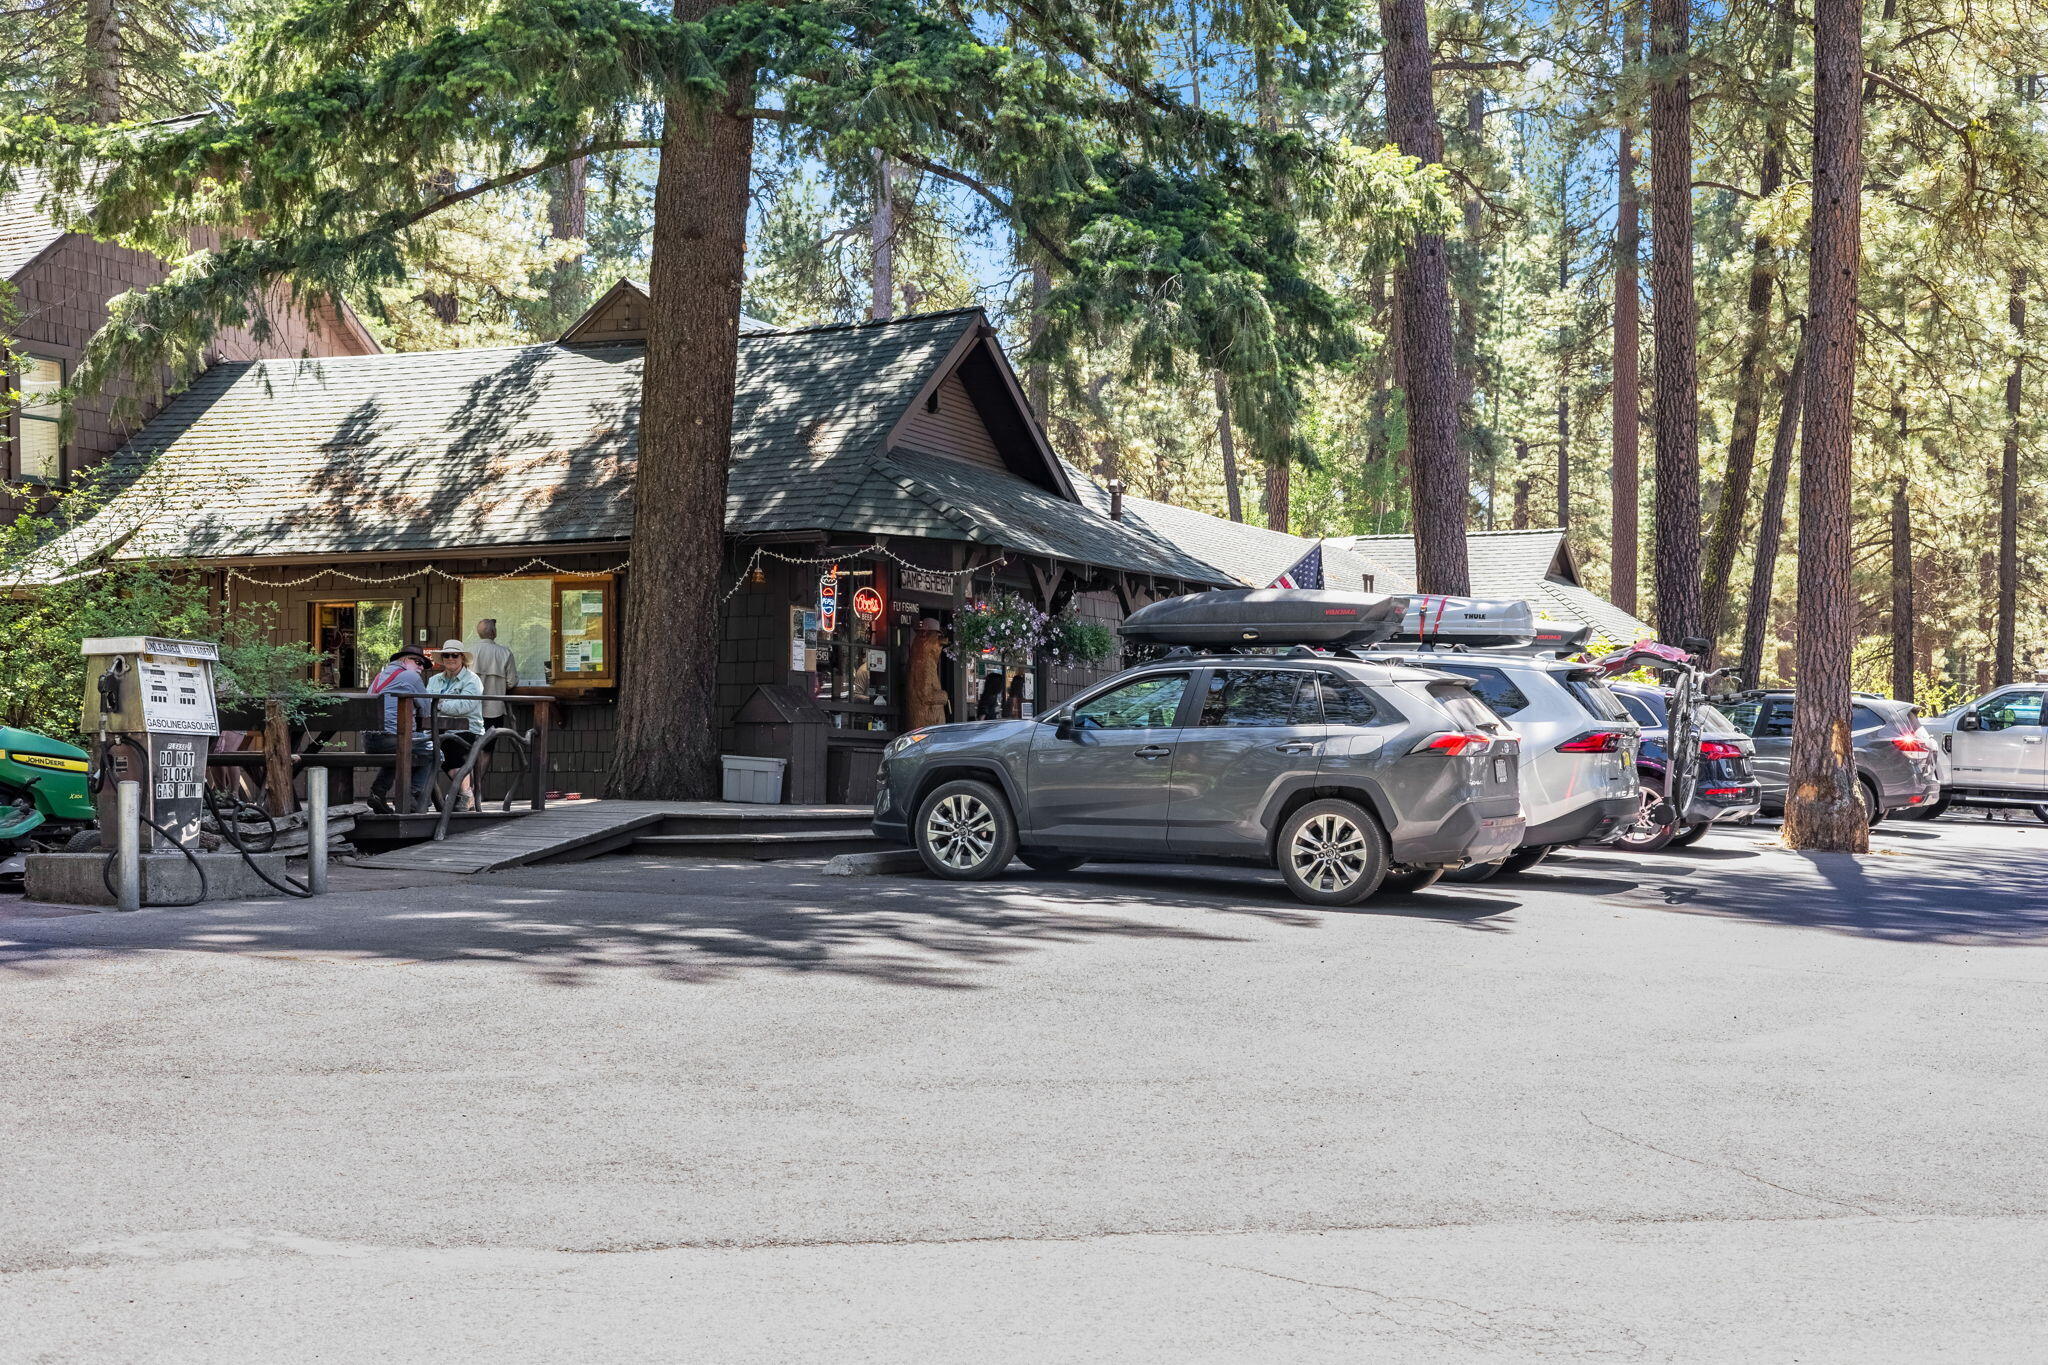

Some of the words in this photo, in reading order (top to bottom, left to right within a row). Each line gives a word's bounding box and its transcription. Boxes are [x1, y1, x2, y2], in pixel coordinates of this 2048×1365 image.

[901, 570, 922, 588] CAMP
[925, 573, 953, 593] SHERM
[856, 594, 880, 612] Coors
[893, 601, 901, 611] FLY
[902, 602, 919, 613] FISHING
[901, 614, 912, 625] ONLY
[146, 640, 180, 654] UNLEADED
[147, 718, 182, 730] GASOLINE
[182, 720, 217, 731] GASOLINE
[26, 756, 45, 765] JOHN
[45, 757, 66, 767] DEERE
[160, 751, 172, 766] DO
[176, 752, 195, 767] NOT
[163, 767, 192, 782] BLOCK
[157, 784, 174, 798] GAS
[178, 783, 202, 798] PUMP
